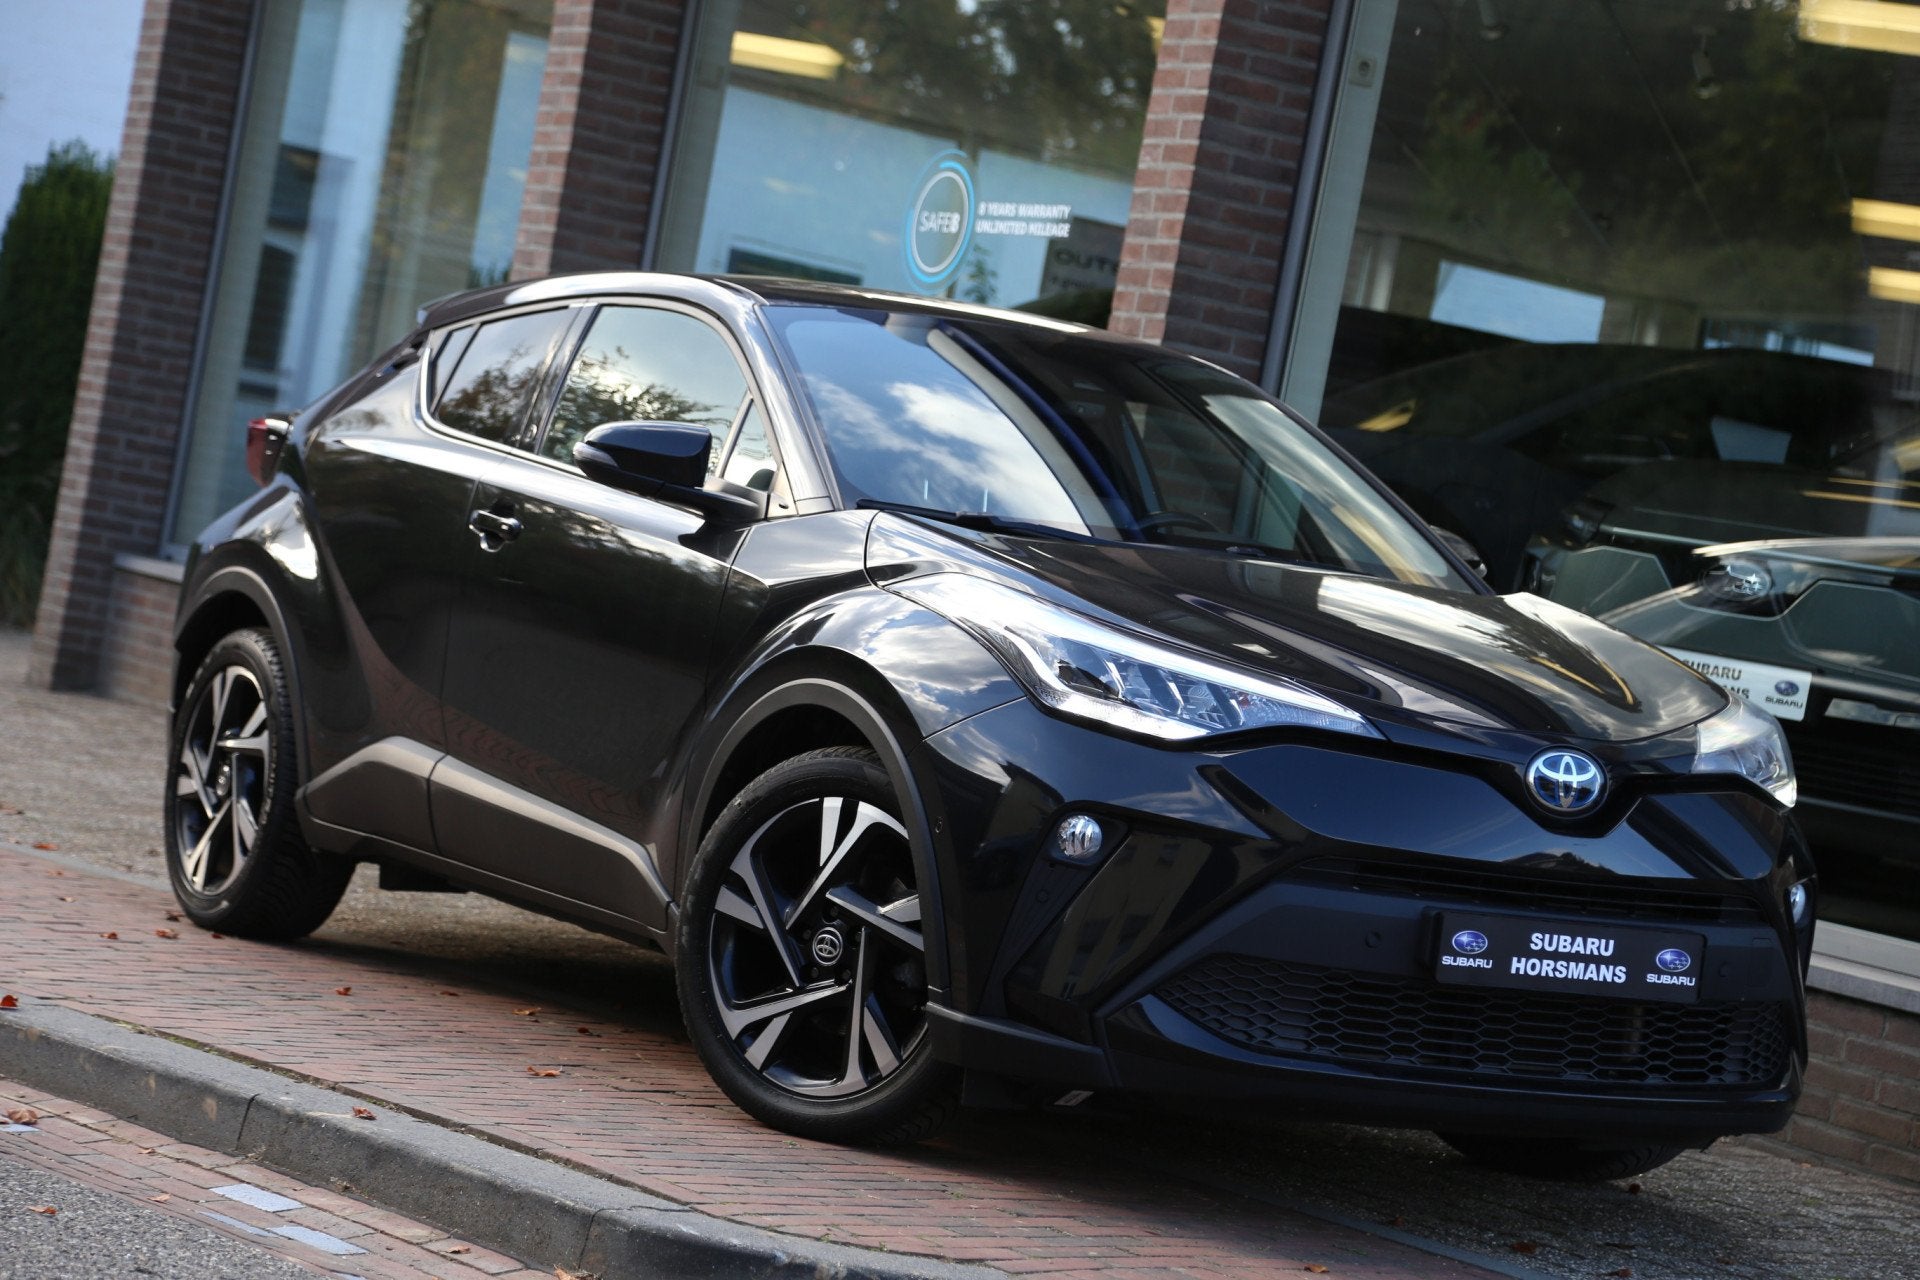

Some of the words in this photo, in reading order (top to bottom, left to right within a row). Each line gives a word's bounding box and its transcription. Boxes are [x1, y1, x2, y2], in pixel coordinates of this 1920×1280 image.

[978, 201, 986, 217] 8
[986, 202, 1017, 218] YEARS
[1018, 203, 1071, 219] WARRANTY
[975, 219, 1028, 236] UNLIMITED
[1028, 221, 1071, 238] MILEAGE
[1765, 696, 1804, 709] SUBARU
[1529, 932, 1615, 957] SUBARU
[1441, 955, 1493, 969] SUBARU
[1510, 956, 1627, 984] HORSMANS
[1646, 973, 1696, 987] SUBARU
